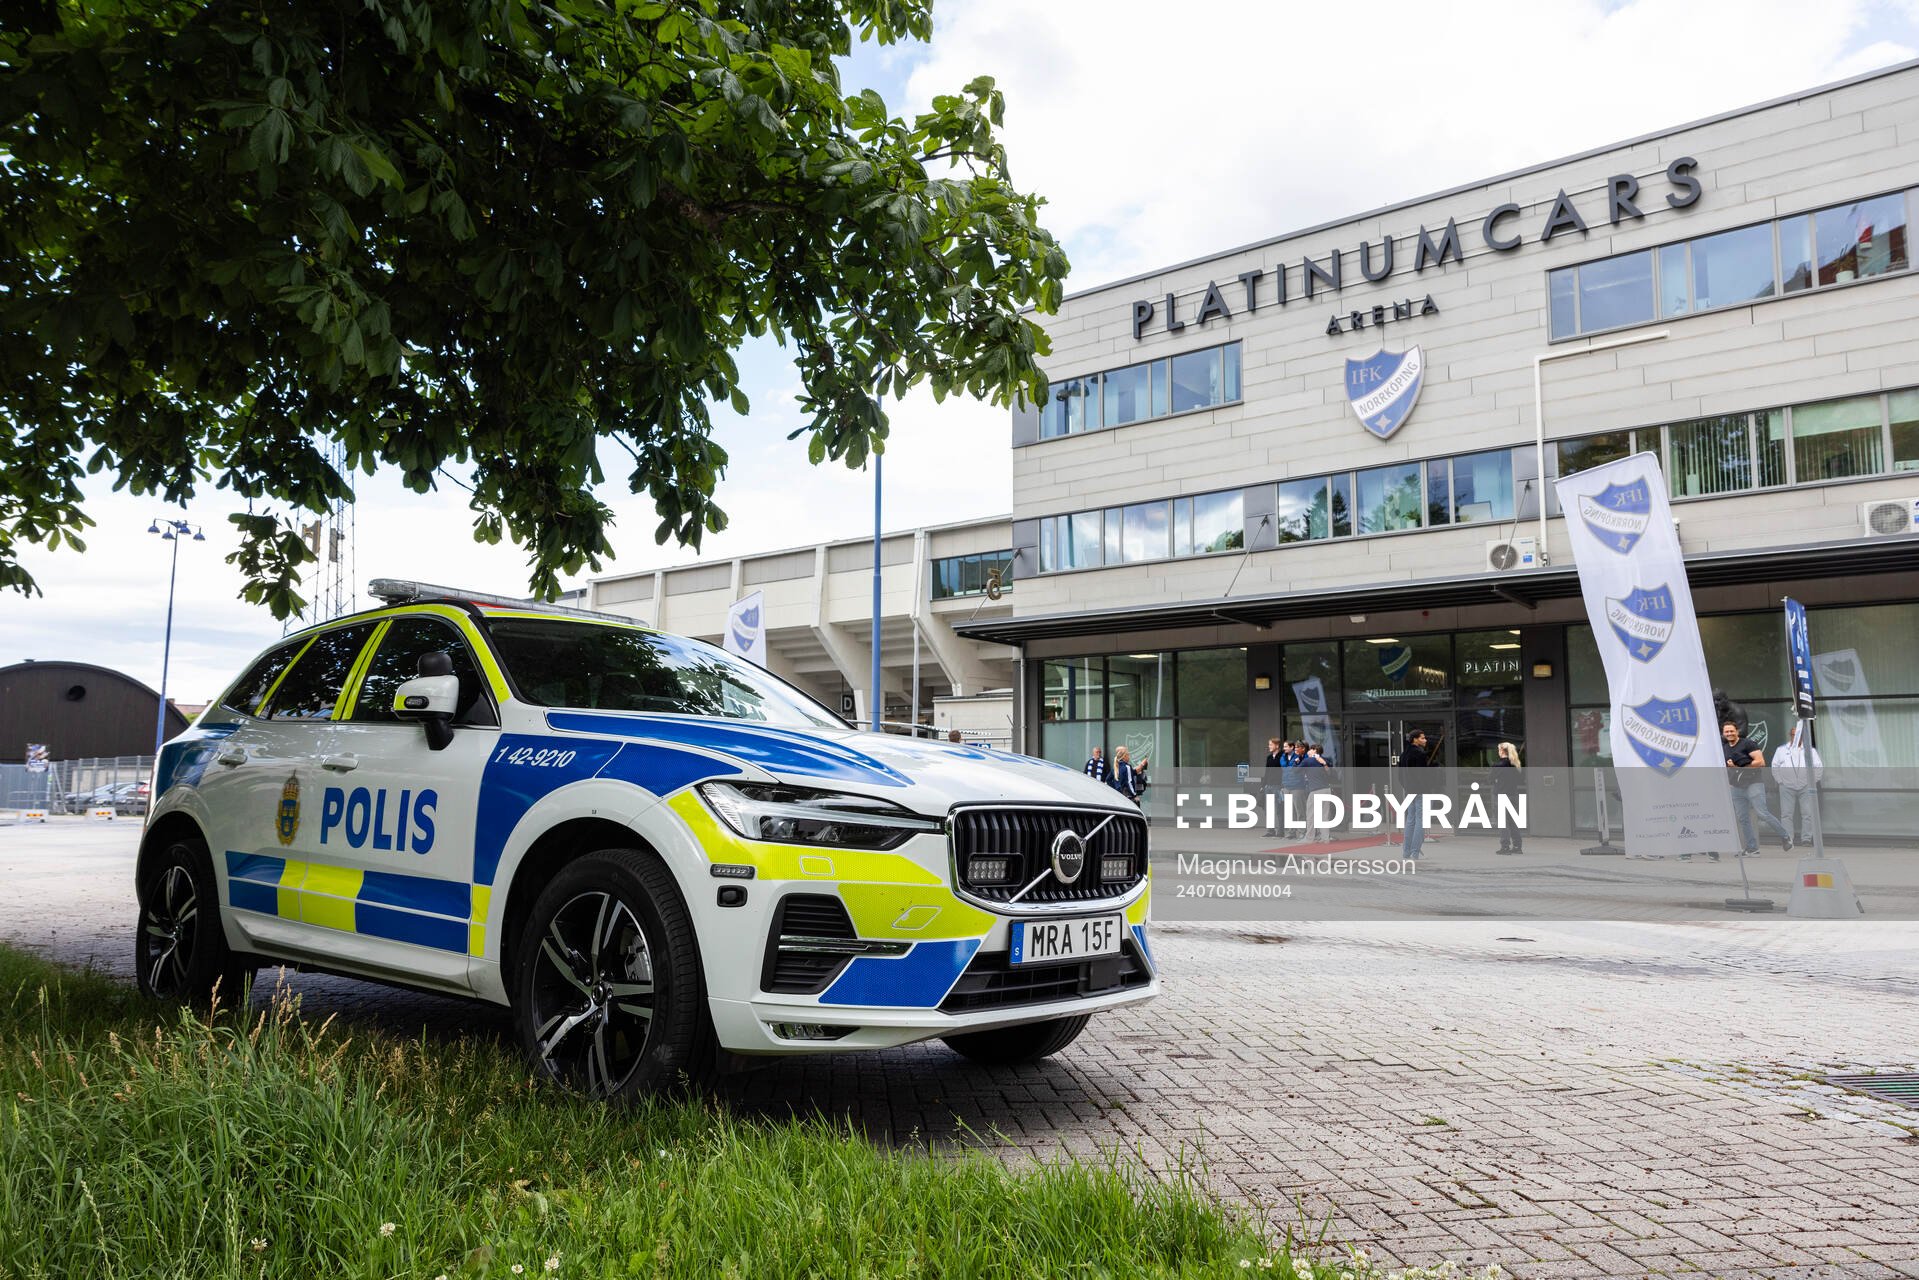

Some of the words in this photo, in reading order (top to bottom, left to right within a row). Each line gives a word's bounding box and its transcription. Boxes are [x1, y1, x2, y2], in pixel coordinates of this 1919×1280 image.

[1325, 293, 1440, 336] ARENA
[1351, 365, 1383, 385] IFK
[1358, 361, 1418, 416] NORRKÖPING
[844, 696, 853, 710] D
[494, 746, 510, 763] 1
[507, 747, 577, 768] 42-9210
[319, 786, 438, 855] POLIS
[1014, 947, 1020, 957] S
[1031, 923, 1073, 957] MRA
[1082, 920, 1113, 953] 15F
